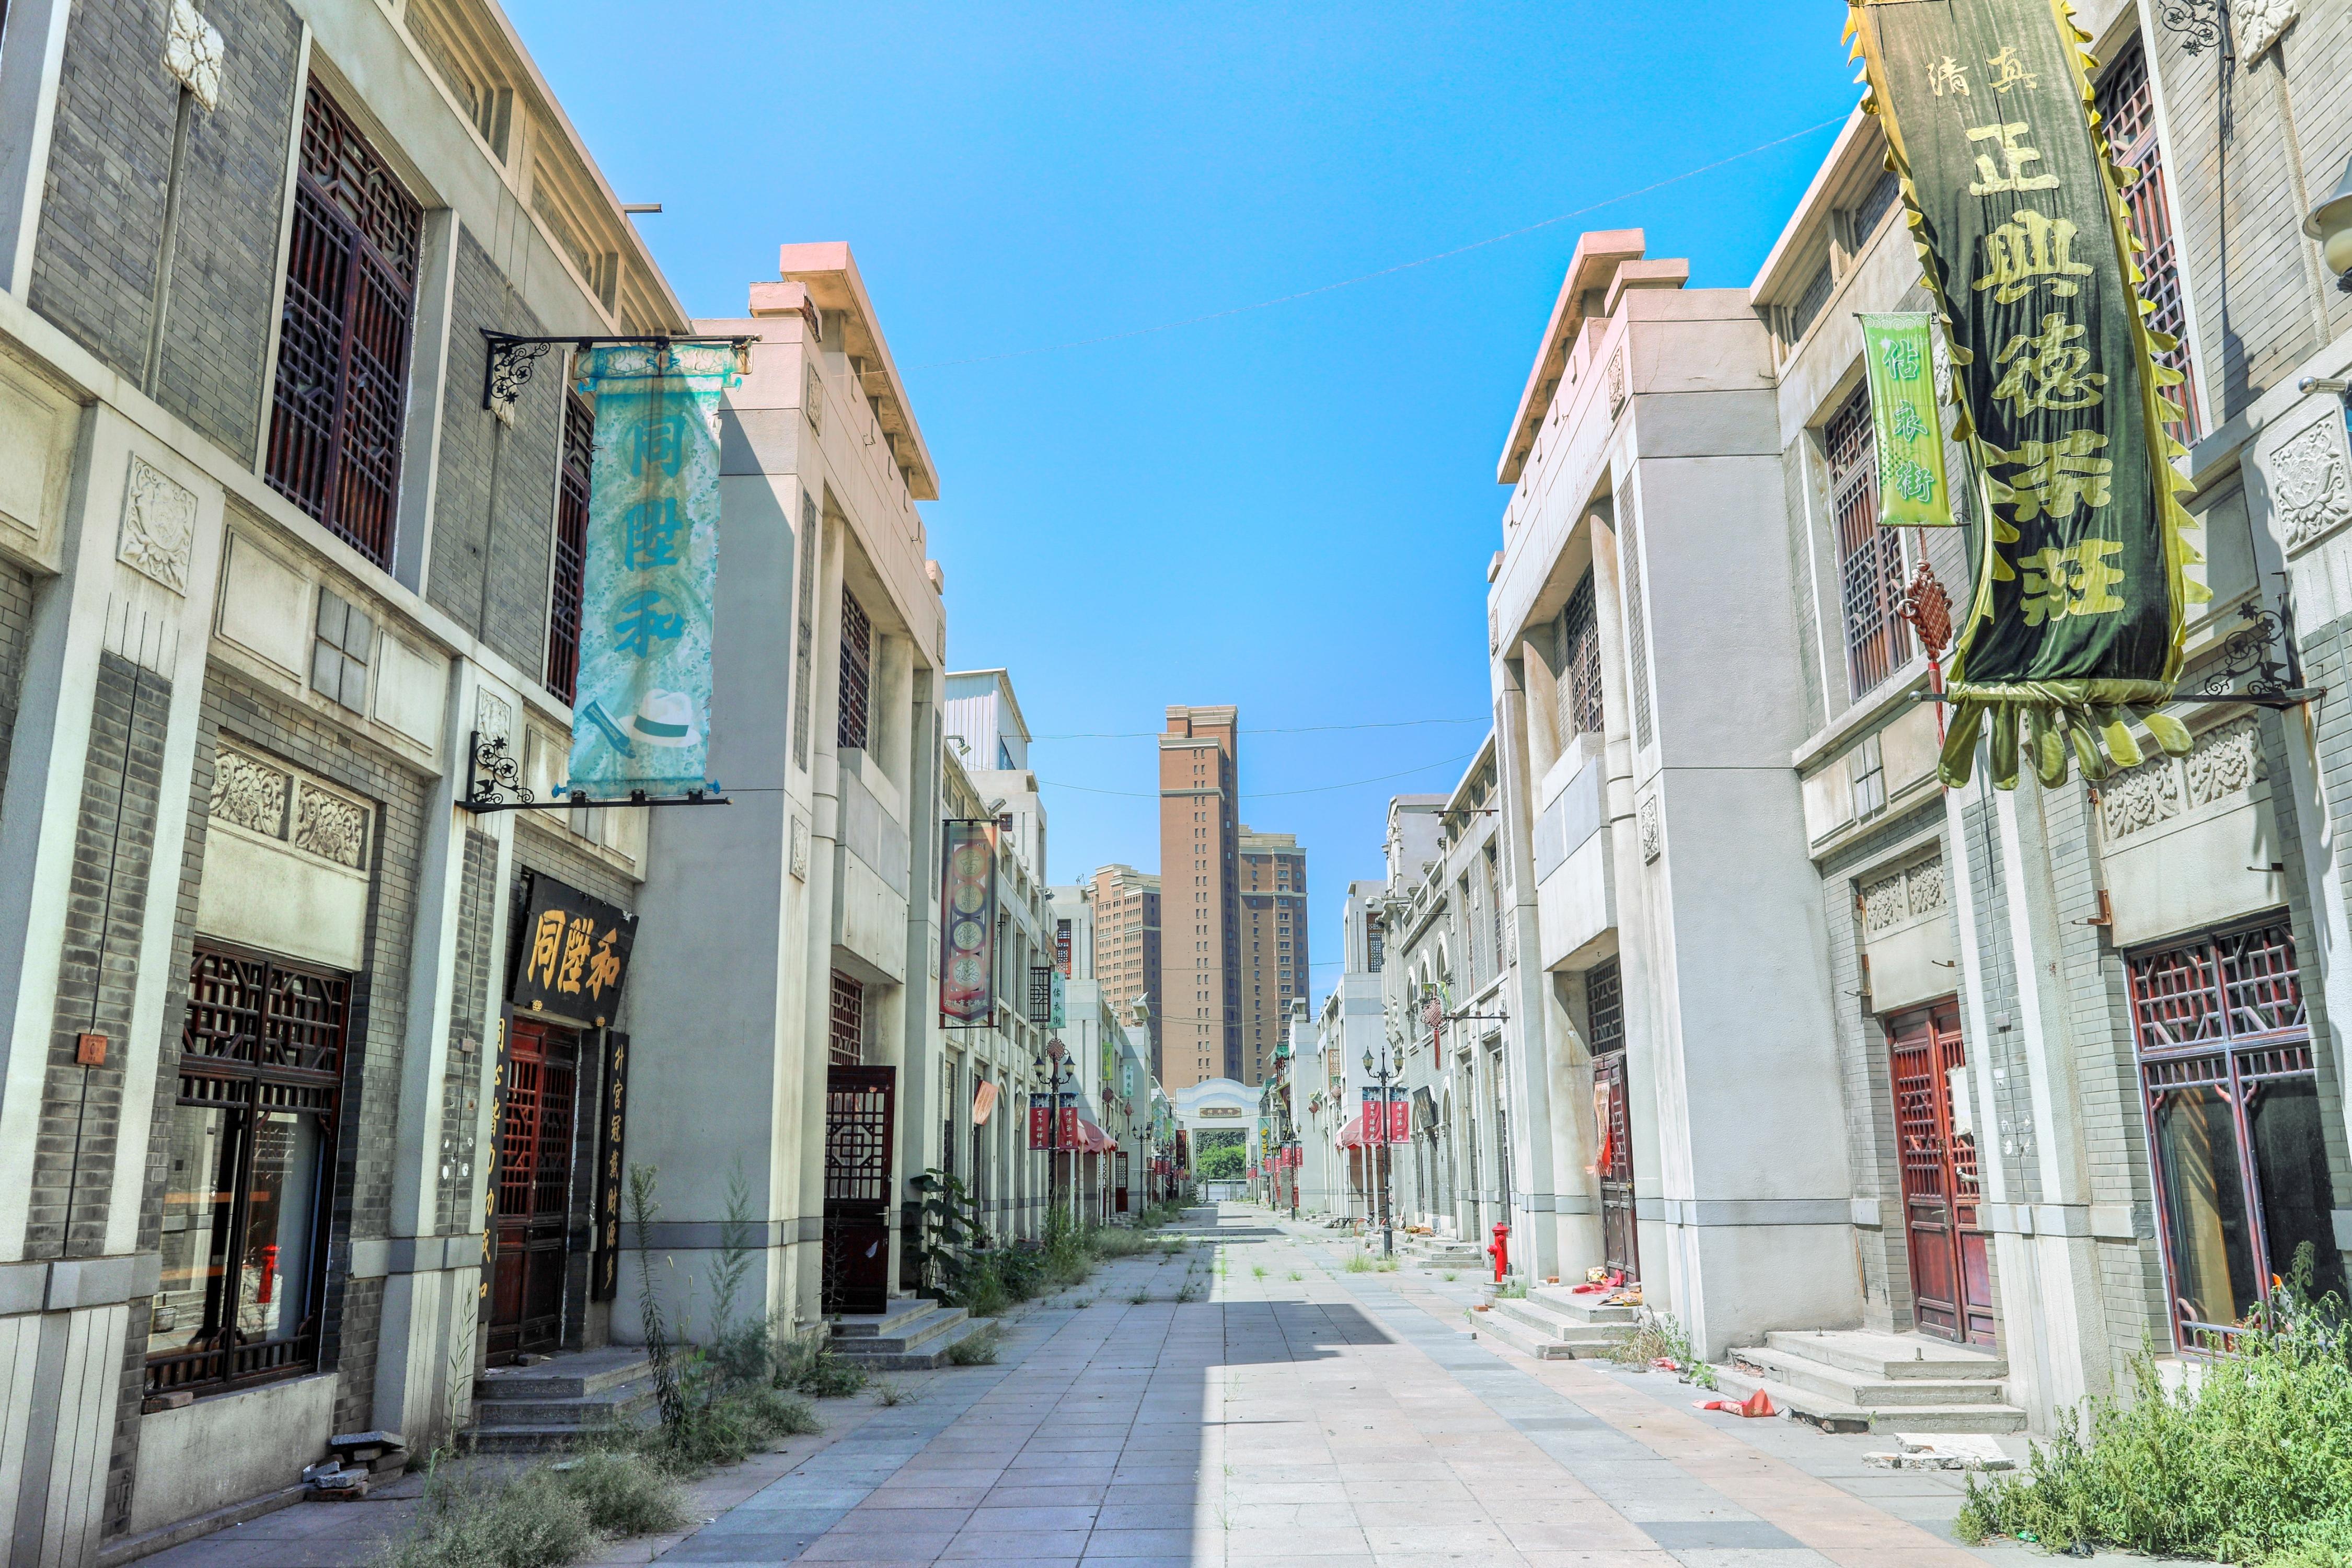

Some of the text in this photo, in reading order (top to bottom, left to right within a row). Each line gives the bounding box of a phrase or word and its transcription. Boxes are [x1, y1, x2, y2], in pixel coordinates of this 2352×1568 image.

[1925, 47, 2037, 98] 清真
[1882, 339, 1934, 503] 估衣街
[1053, 987, 1061, 1025] 估衣街
